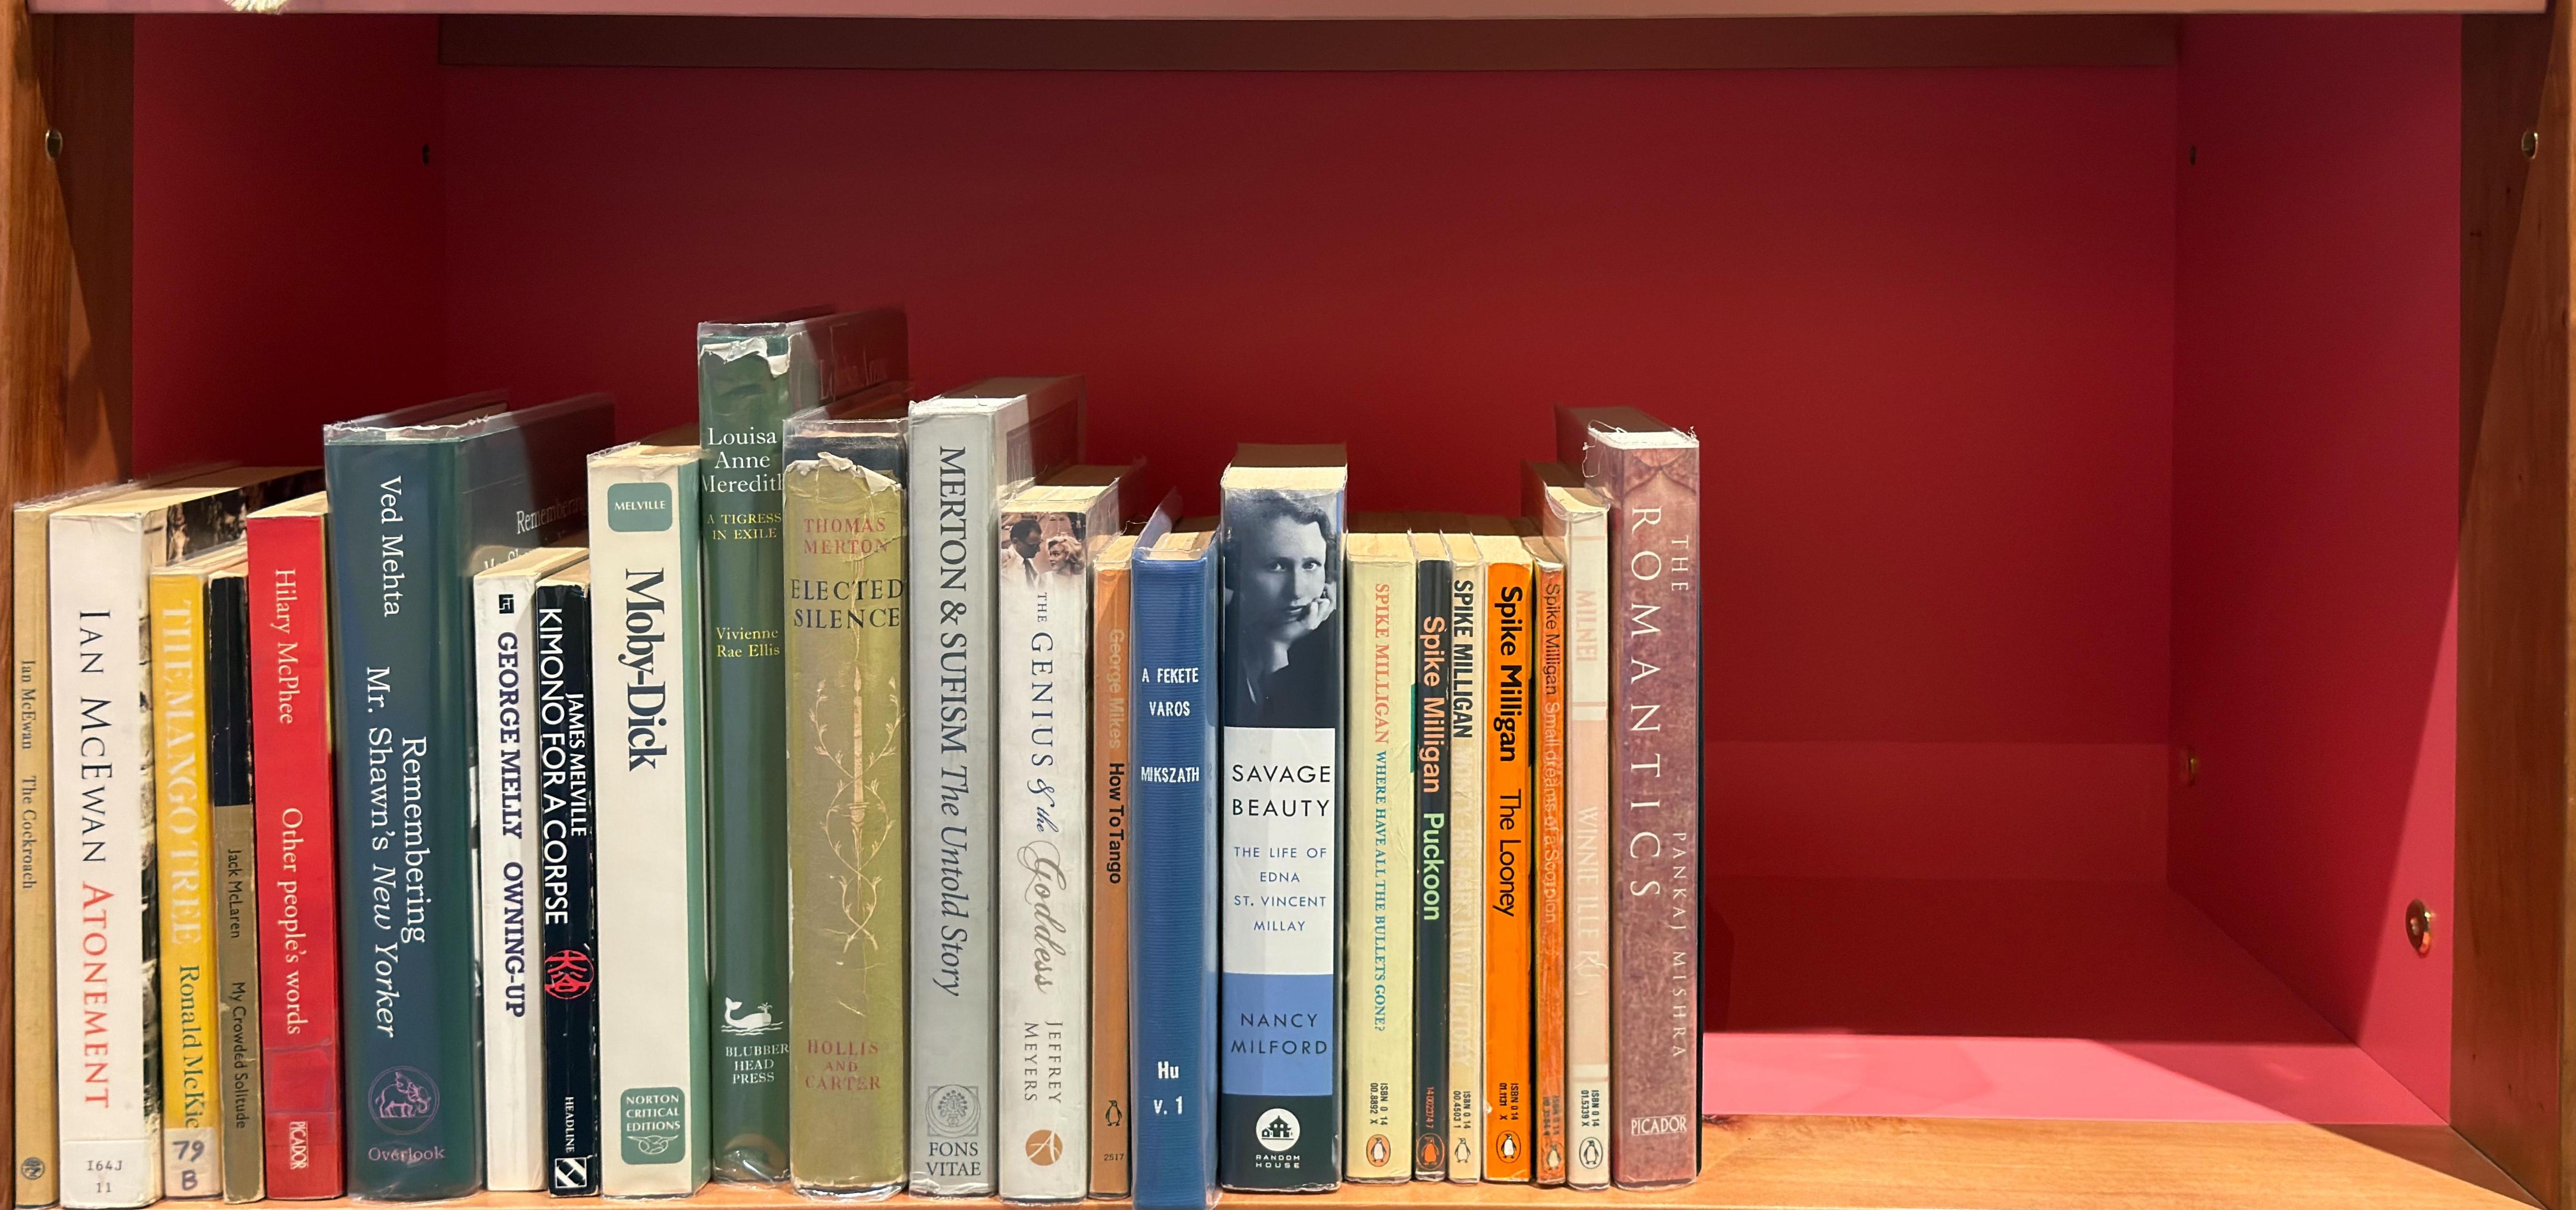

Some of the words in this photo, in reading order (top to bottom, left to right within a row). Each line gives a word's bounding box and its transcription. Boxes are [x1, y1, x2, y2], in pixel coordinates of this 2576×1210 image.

[707, 427, 777, 446] Louisa
[714, 451, 771, 470] Anne
[380, 475, 403, 524] Ved
[614, 500, 666, 511] MELVILLE
[707, 514, 715, 524] A
[721, 513, 782, 525] TIGRESS
[939, 446, 966, 591] MERTON
[712, 529, 726, 540] IN
[734, 528, 777, 539] EXILE
[804, 517, 886, 533] THOMAS
[804, 538, 888, 554] MERTON
[382, 534, 405, 617] Mehta
[1671, 535, 1689, 592] THE
[270, 569, 298, 635] Hilary
[791, 579, 905, 601] ELECTED
[940, 600, 967, 626] &
[1037, 592, 1047, 623] THE
[1375, 583, 1390, 639] SPIKE
[1453, 579, 1474, 638] SPIKE
[1543, 584, 1561, 630] Spike
[79, 610, 111, 675] IAN
[161, 600, 194, 682] THE
[716, 627, 779, 641] Vivienne
[793, 608, 900, 629] SILENCE
[1494, 586, 1523, 656] Spike
[21, 660, 36, 682] Ian
[539, 608, 565, 726] KIMONO
[618, 567, 668, 772] Moby-Dick
[717, 645, 742, 658] Rae
[748, 643, 781, 657] Ellis
[1106, 628, 1125, 693] George
[1419, 616, 1446, 688] Spike
[1542, 634, 1561, 695] Milligan
[277, 641, 301, 724] McPhee
[366, 666, 391, 713] Mr.
[497, 631, 520, 744] GEORGE
[940, 632, 967, 754] SUFISM
[1031, 631, 1053, 766] GENIUS
[1142, 668, 1150, 683] A
[1157, 667, 1199, 683] FEKETE
[1375, 644, 1390, 744] MILLIGAN
[1452, 643, 1474, 738] MILLIGAN
[21, 688, 37, 750] McEwan
[565, 693, 586, 749] JAMES
[1109, 697, 1125, 749] Mikes
[1149, 701, 1191, 717] VAROS
[1493, 665, 1523, 762] Milligan
[1544, 702, 1561, 747] Small
[1630, 507, 1662, 897] ROMANTICS
[164, 689, 199, 834] MANGO
[542, 733, 567, 788] FOR
[1419, 697, 1446, 793] Milligan
[22, 776, 37, 804] The
[369, 727, 396, 852] Shawn's
[501, 749, 523, 839] MELLY
[569, 754, 587, 837] MELVILLE
[940, 765, 969, 817] The
[1027, 778, 1055, 808] &
[1109, 763, 1124, 801] How
[1140, 766, 1200, 783] MIKSZATH
[1232, 764, 1330, 784] SAVAGE
[1375, 750, 1387, 804] WHERE
[543, 793, 567, 813] A
[1036, 805, 1059, 833] the
[1109, 805, 1124, 827] To
[1232, 798, 1330, 817] BEAUTY
[1375, 808, 1386, 846] HAVE
[1499, 788, 1522, 831] The
[22, 809, 37, 890] Cockroach
[228, 848, 242, 877] Jack
[282, 807, 304, 872] Other
[401, 736, 432, 943] Remembering
[1106, 829, 1124, 884] Tango
[1234, 846, 1260, 858] THE
[1269, 846, 1297, 858] LIFE
[1307, 847, 1327, 858] OF
[1375, 849, 1386, 878] ALL
[1577, 806, 1600, 887] WINNIE
[543, 820, 568, 925] CORPSE
[940, 826, 970, 918] Untold
[1260, 872, 1300, 882] EDNA
[1423, 812, 1445, 921] Puckoon
[1492, 839, 1522, 918] Looney
[1669, 832, 1687, 930] PANKAJ
[170, 842, 202, 946] TREE
[228, 881, 243, 938] McLaren
[373, 863, 396, 930] New
[1017, 840, 1067, 994] Goddess
[1234, 895, 1254, 907] ST.
[1261, 896, 1326, 907] VINCENT
[1375, 879, 1386, 912] THE
[1577, 896, 1600, 939] ILLE
[277, 880, 307, 964] people's
[503, 861, 526, 1018] OWNING-UP
[1253, 921, 1306, 931] MILLAY
[932, 925, 968, 997] Story
[1375, 915, 1386, 981] BULLETS
[82, 881, 116, 1108] ATONEMENT
[179, 964, 202, 1048] Ronald
[229, 982, 246, 1002] My
[285, 969, 309, 1035] words
[375, 941, 401, 1039] Yorker
[1374, 984, 1386, 1031] GONE?
[1672, 951, 1687, 1057] MISHRA
[232, 1006, 247, 1069] Crowded
[1241, 1013, 1318, 1028] NANCY
[726, 1043, 789, 1057] BLUBBER
[734, 1059, 774, 1071] HEAD
[808, 1039, 879, 1056] HOLLIS
[824, 1061, 859, 1072] AND
[1024, 1022, 1039, 1102] MEYERS
[1045, 1021, 1063, 1104] JEFFREY
[1157, 1061, 1179, 1079] Hu
[1231, 1040, 1328, 1055] MILFORD
[183, 1055, 205, 1128] McKie
[234, 1073, 250, 1129] Solitude
[626, 1094, 680, 1105] NORTON
[732, 1072, 775, 1085] PRESS
[805, 1076, 881, 1091] CARTER
[1380, 1082, 1389, 1102] ISBN
[1591, 1089, 1600, 1108] ISBN
[564, 1097, 575, 1154] HEADLINE
[626, 1107, 680, 1118] CRITICAL
[626, 1121, 681, 1132] EDITIONS
[1153, 1099, 1168, 1115] v.
[1175, 1095, 1183, 1115] 1
[1380, 1116, 1388, 1126] 14
[1591, 1118, 1600, 1127] 14
[1630, 1115, 1687, 1135] PICADOR
[172, 1139, 204, 1162] 79
[289, 1121, 309, 1170] PICADOR
[368, 1147, 446, 1163] Overlook
[925, 1162, 981, 1177] VITAE
[929, 1142, 978, 1157] FONS
[97, 1182, 112, 1193] 11
[181, 1169, 198, 1191] B
